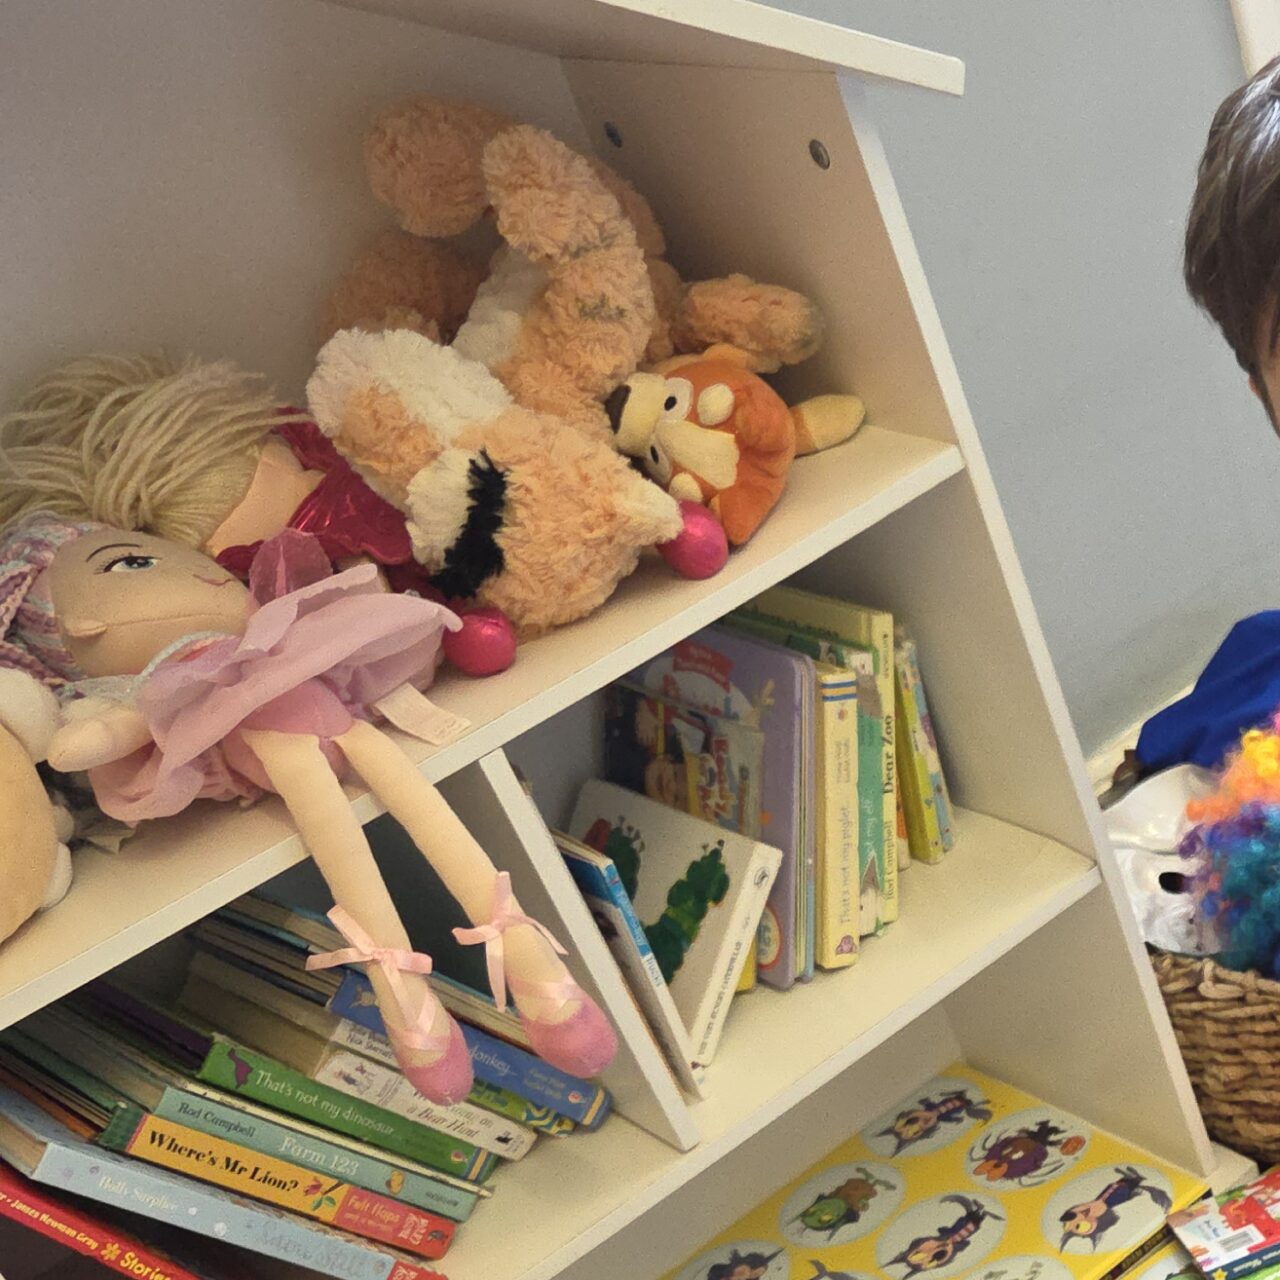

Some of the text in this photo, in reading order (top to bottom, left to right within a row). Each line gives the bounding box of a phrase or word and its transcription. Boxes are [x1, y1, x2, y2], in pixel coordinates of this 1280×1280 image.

[881, 715, 895, 794] Dear Zoo
[256, 1069, 296, 1100] That's
[297, 1085, 319, 1107] not
[320, 1097, 342, 1120] my
[177, 1101, 257, 1138] Rod Campbell
[417, 1106, 449, 1132] Bear
[448, 1115, 480, 1140] Hunt
[148, 1130, 299, 1194] Where's Mr Lion?
[280, 1135, 361, 1179] Farm 123
[10, 1200, 99, 1251] James Newman Gray
[348, 1195, 374, 1214] Felt
